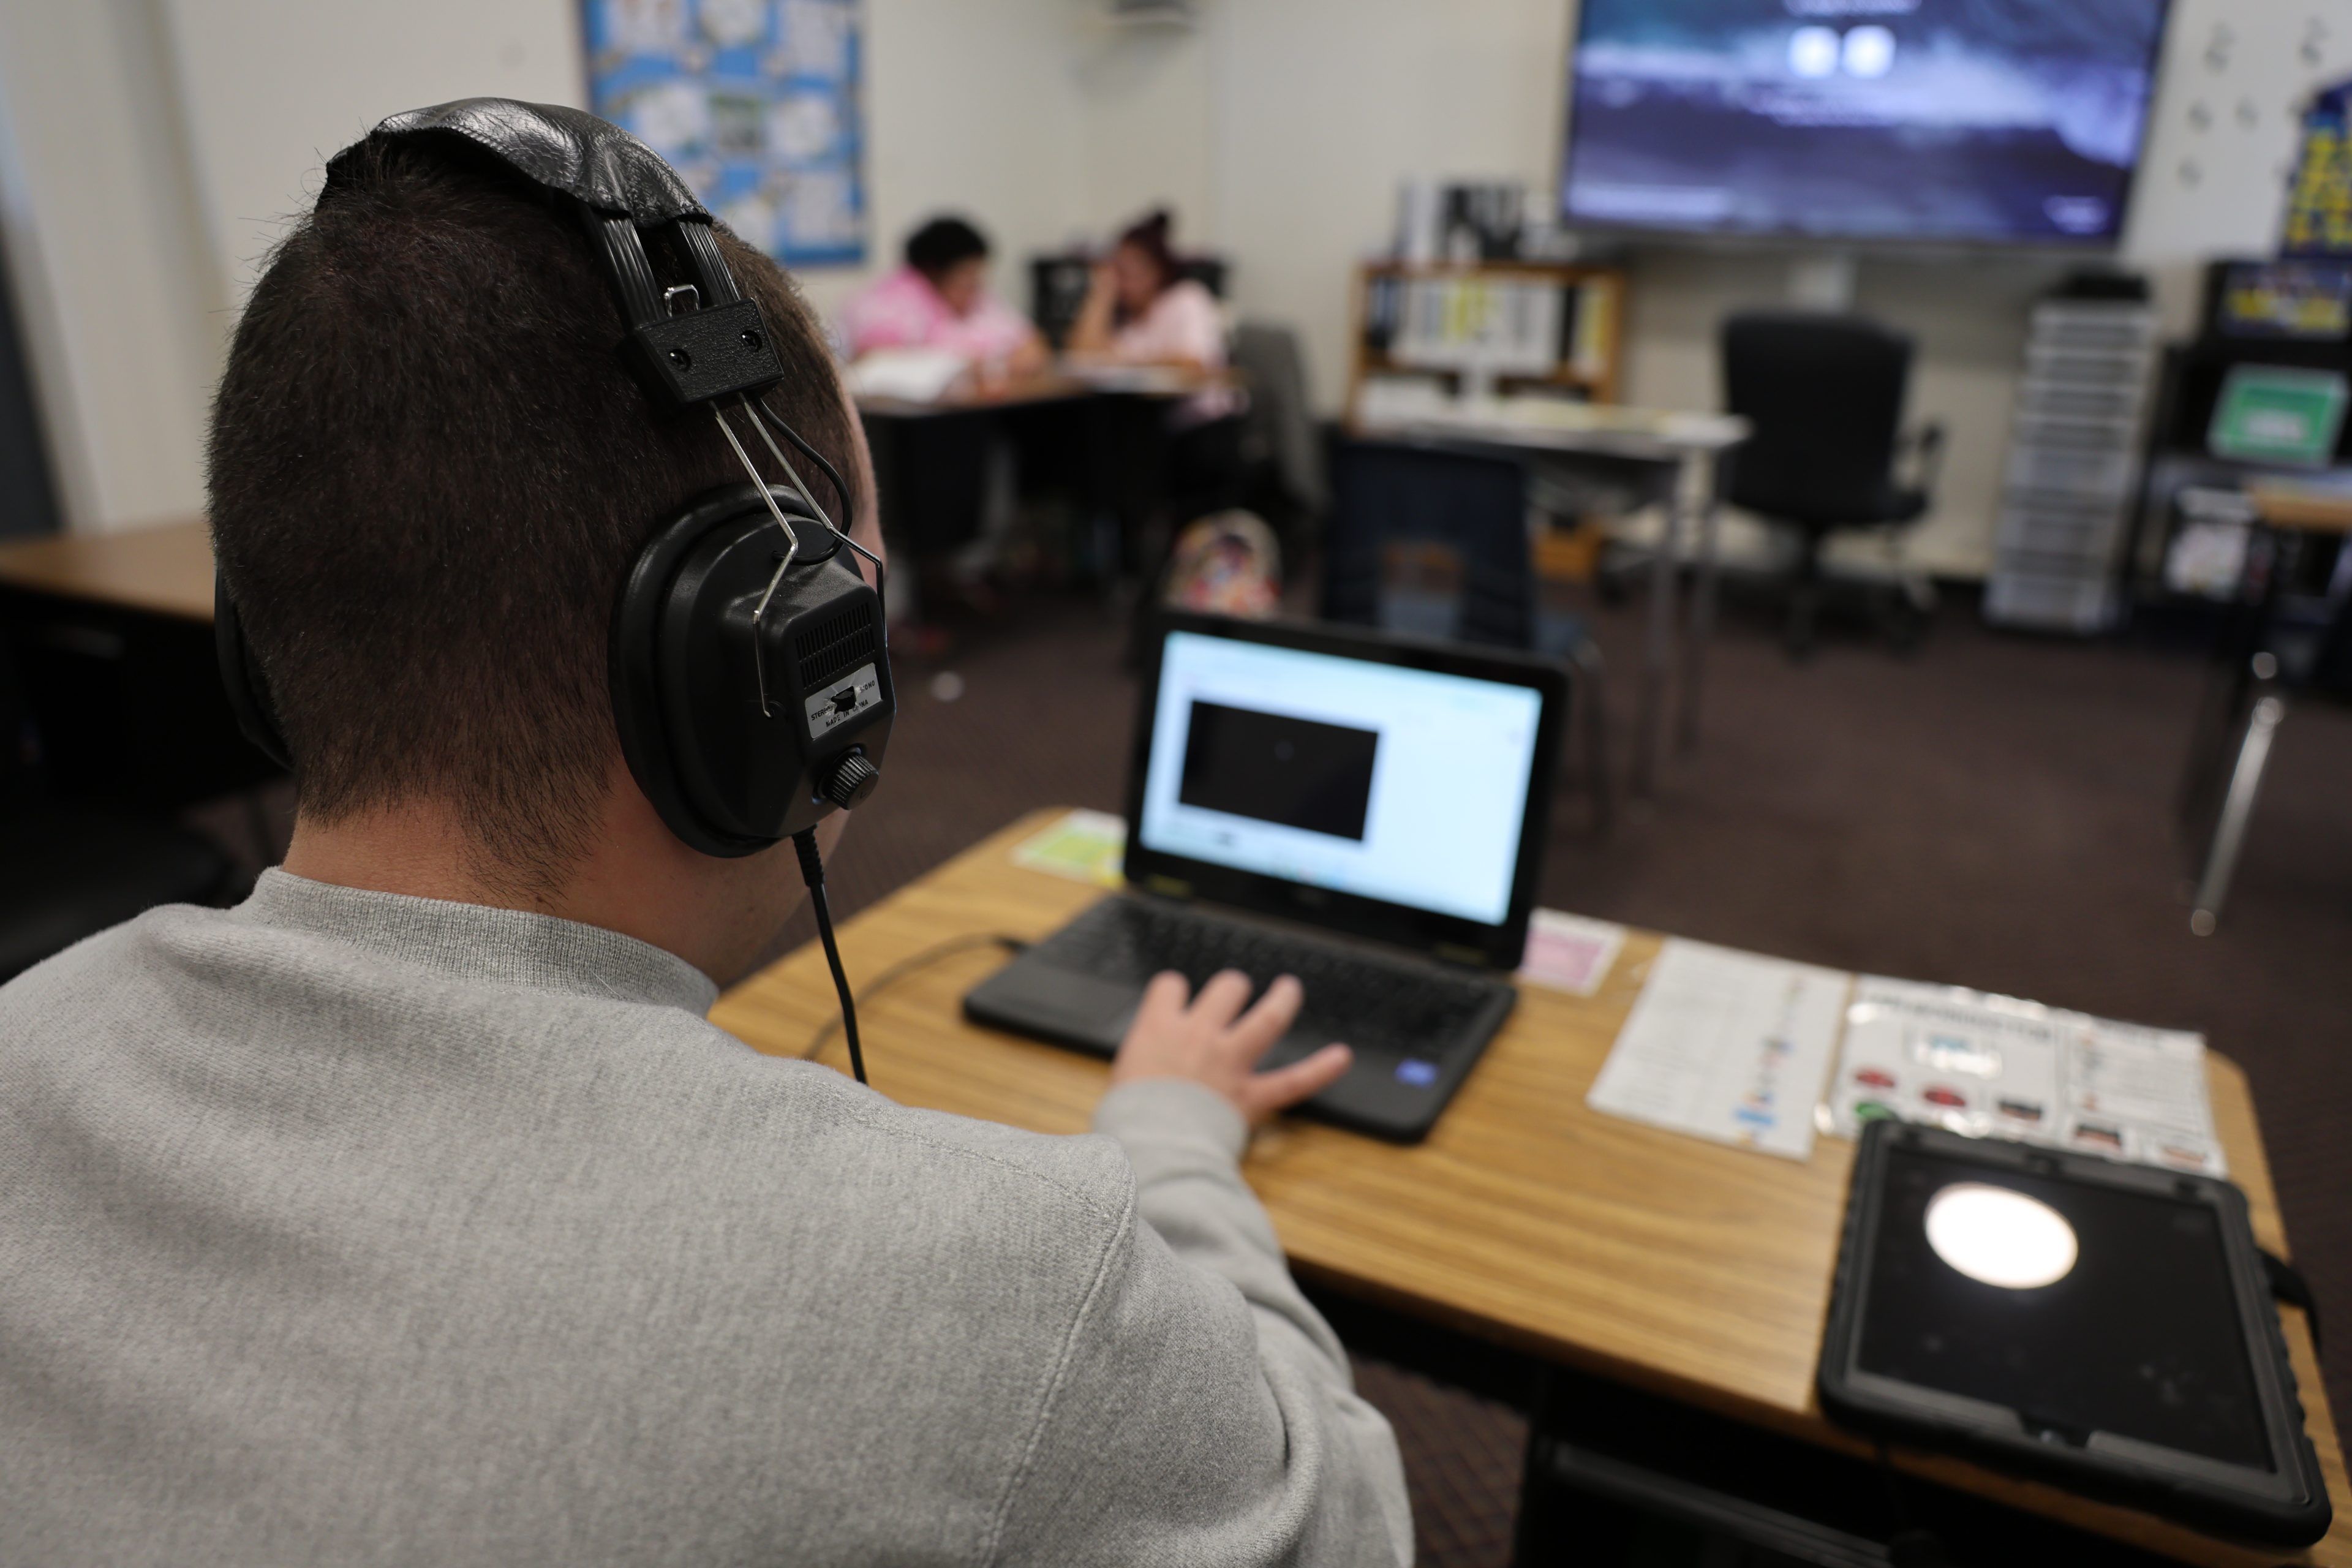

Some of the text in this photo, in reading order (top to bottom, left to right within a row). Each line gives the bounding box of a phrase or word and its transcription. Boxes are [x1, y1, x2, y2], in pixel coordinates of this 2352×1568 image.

[812, 706, 834, 720] STEREO
[826, 715, 840, 727] MADE
[852, 699, 869, 712] CHINA
